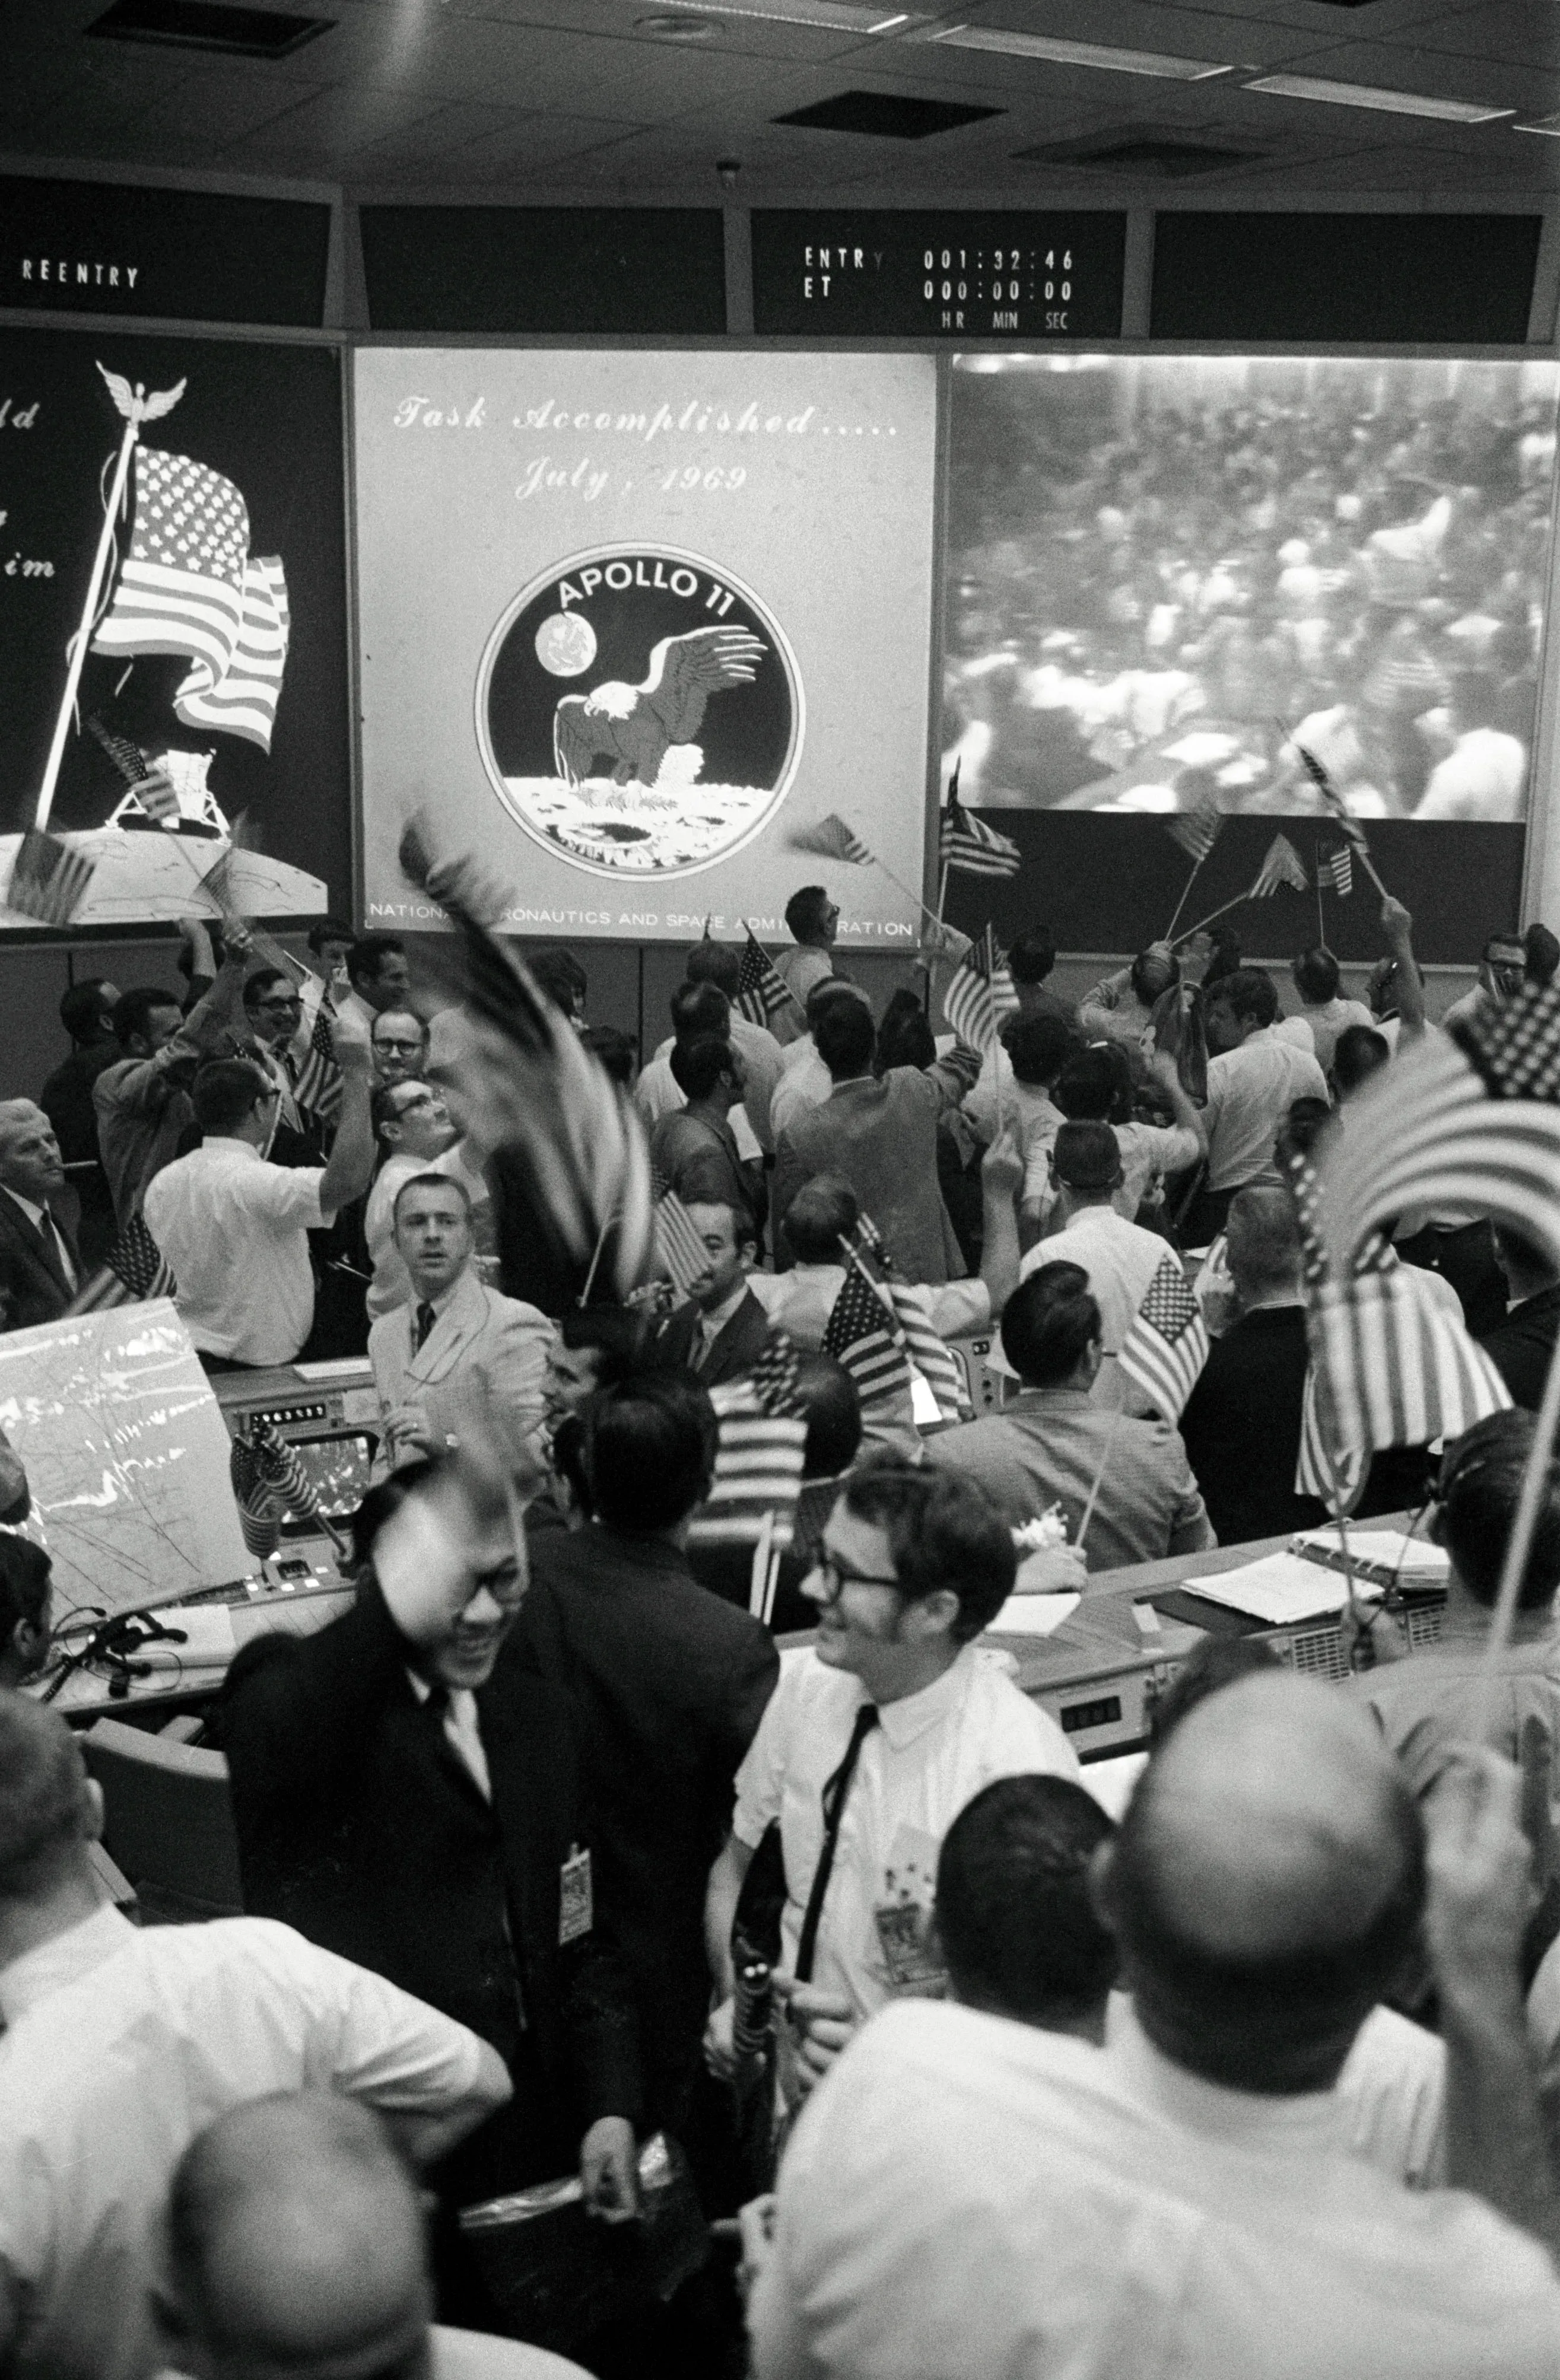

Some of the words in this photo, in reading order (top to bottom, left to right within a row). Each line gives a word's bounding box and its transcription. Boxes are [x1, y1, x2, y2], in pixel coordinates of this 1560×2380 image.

[804, 246, 883, 268] ENTRY
[22, 259, 138, 288] REENTRY
[803, 275, 831, 298] ET
[941, 311, 965, 329] HR
[992, 311, 1019, 329] MIN
[1045, 311, 1067, 330] SEC
[393, 396, 487, 428] Task
[662, 466, 747, 490] 1969
[558, 560, 698, 608] APOLLO
[704, 584, 735, 618] 11
[618, 914, 658, 927] AND
[666, 915, 725, 929] SPACE
